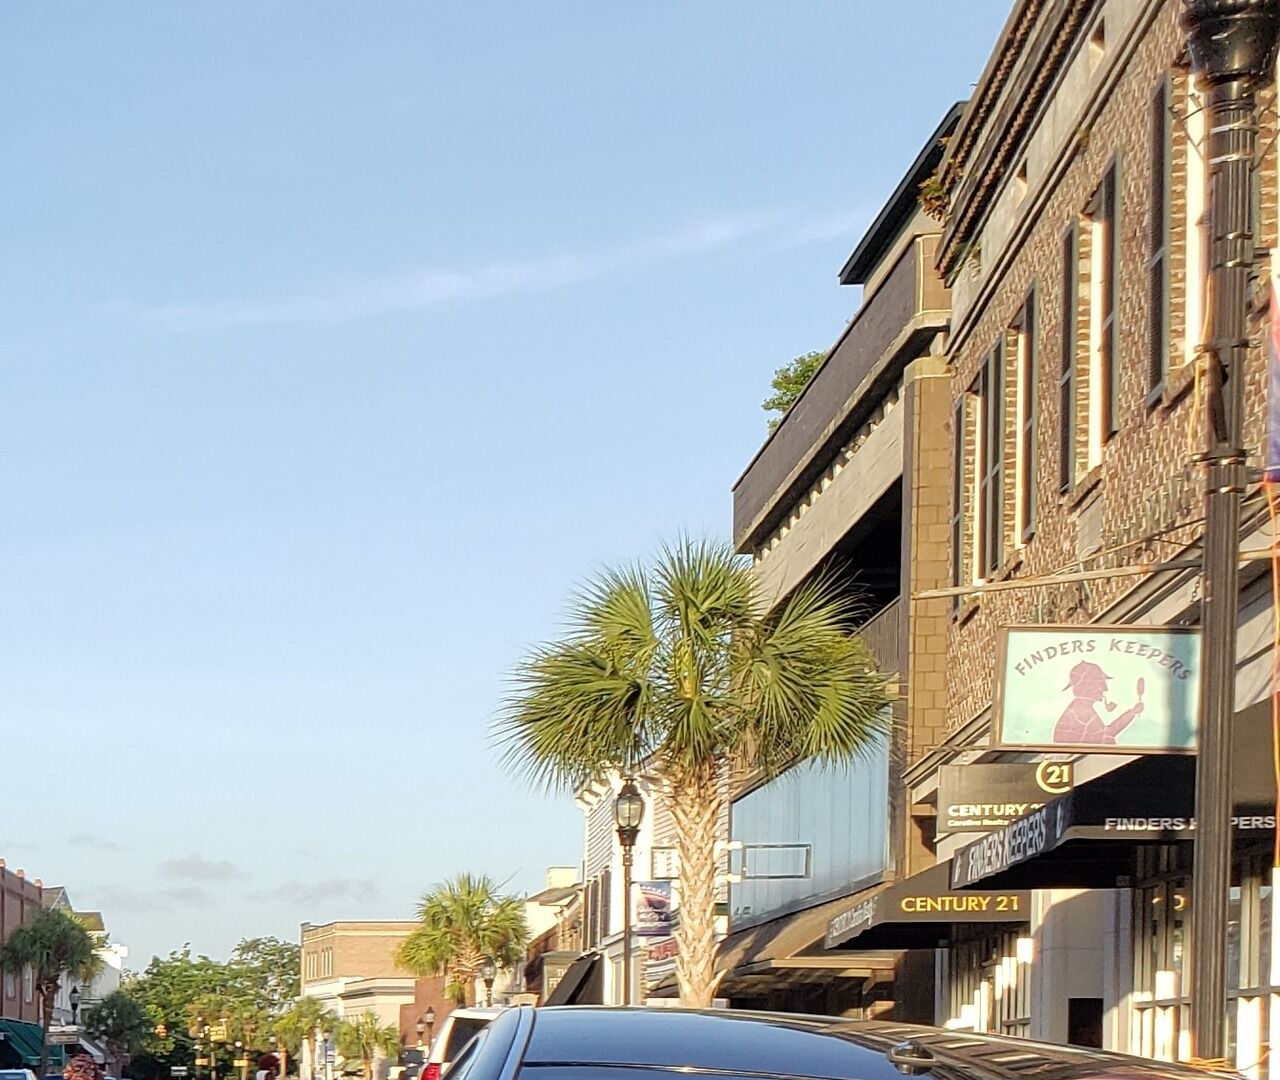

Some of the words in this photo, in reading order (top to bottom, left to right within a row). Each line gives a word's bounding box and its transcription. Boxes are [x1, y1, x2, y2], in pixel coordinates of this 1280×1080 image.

[1014, 639, 1096, 676] FINDERS
[1108, 638, 1192, 681] KEEPERS
[947, 803, 1026, 817] CENTURY
[1104, 817, 1186, 831] FINDERS
[1003, 807, 1047, 867] KEEPERS
[901, 896, 991, 912] CENTURY
[995, 896, 1019, 911] 21
